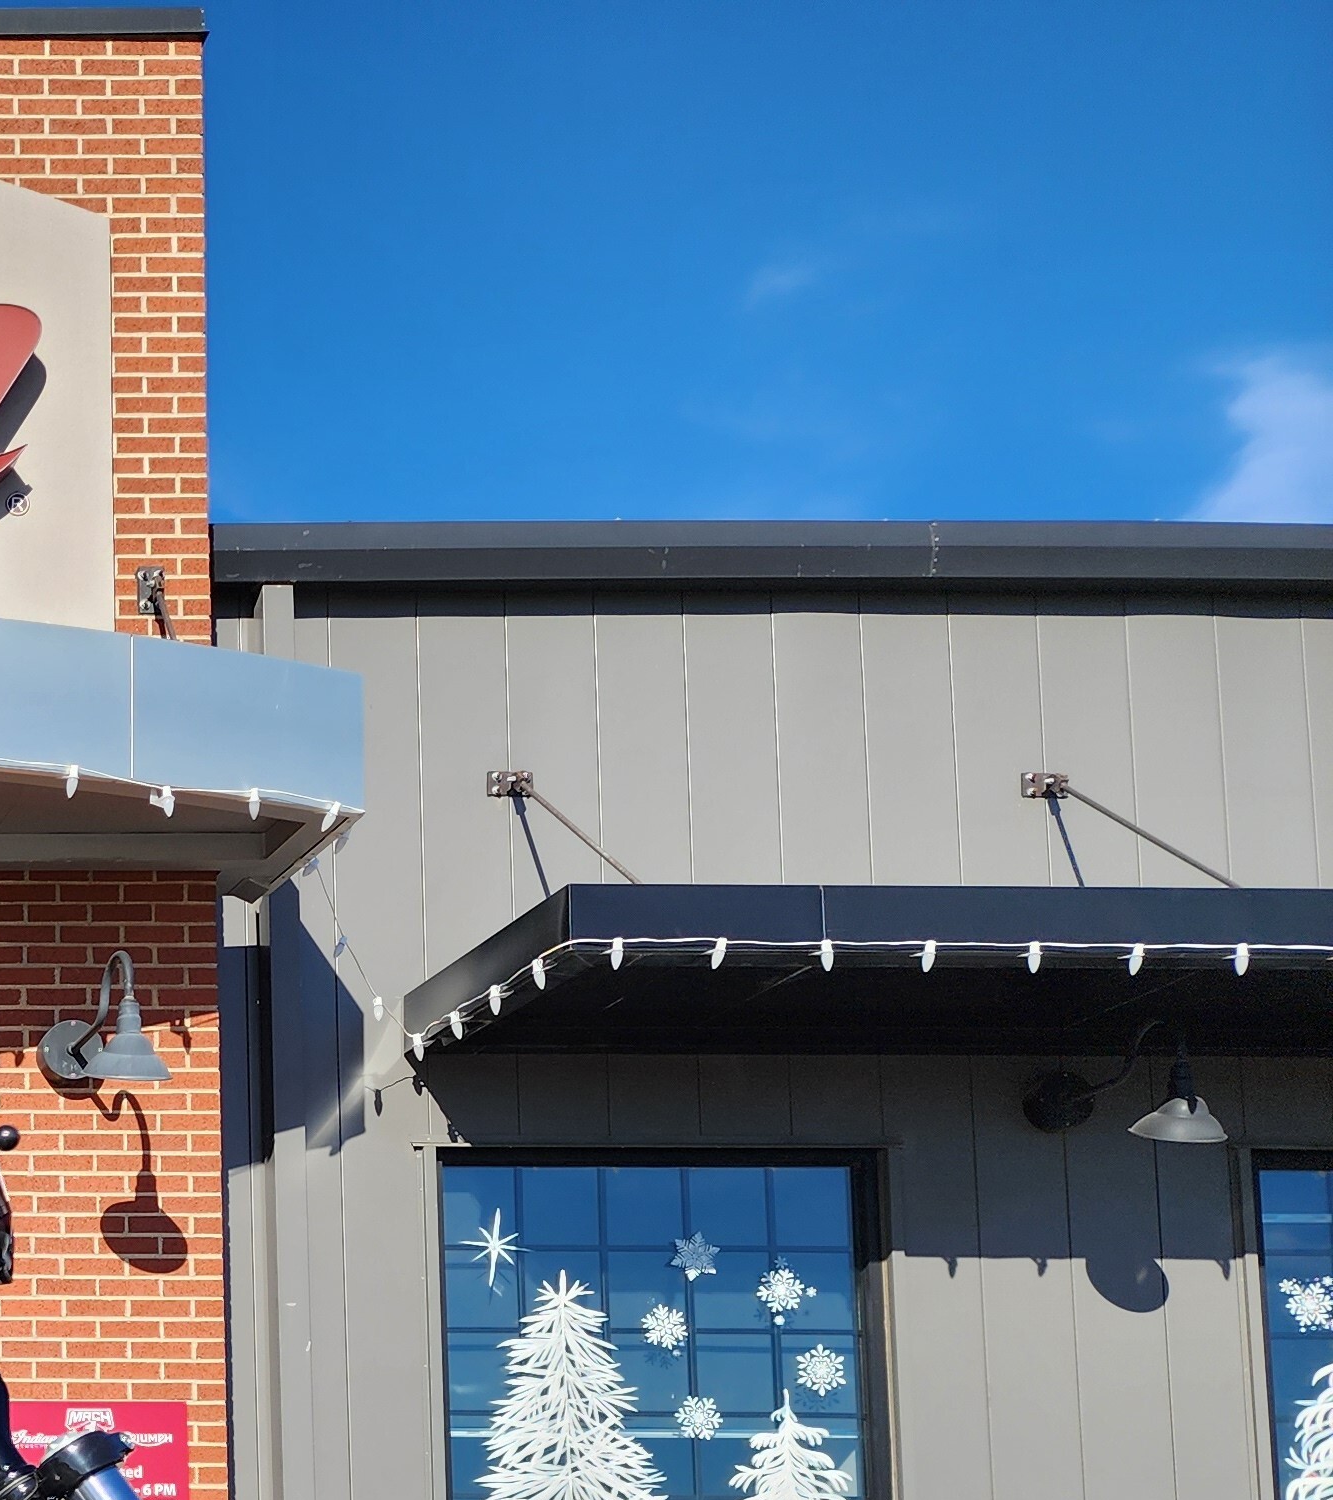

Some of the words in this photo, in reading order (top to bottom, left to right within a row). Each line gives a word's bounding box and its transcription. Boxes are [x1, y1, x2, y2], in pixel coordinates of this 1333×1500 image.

[67, 1410, 111, 1426] MACH
[142, 1483, 152, 1496] 6
[154, 1482, 177, 1496] PM
